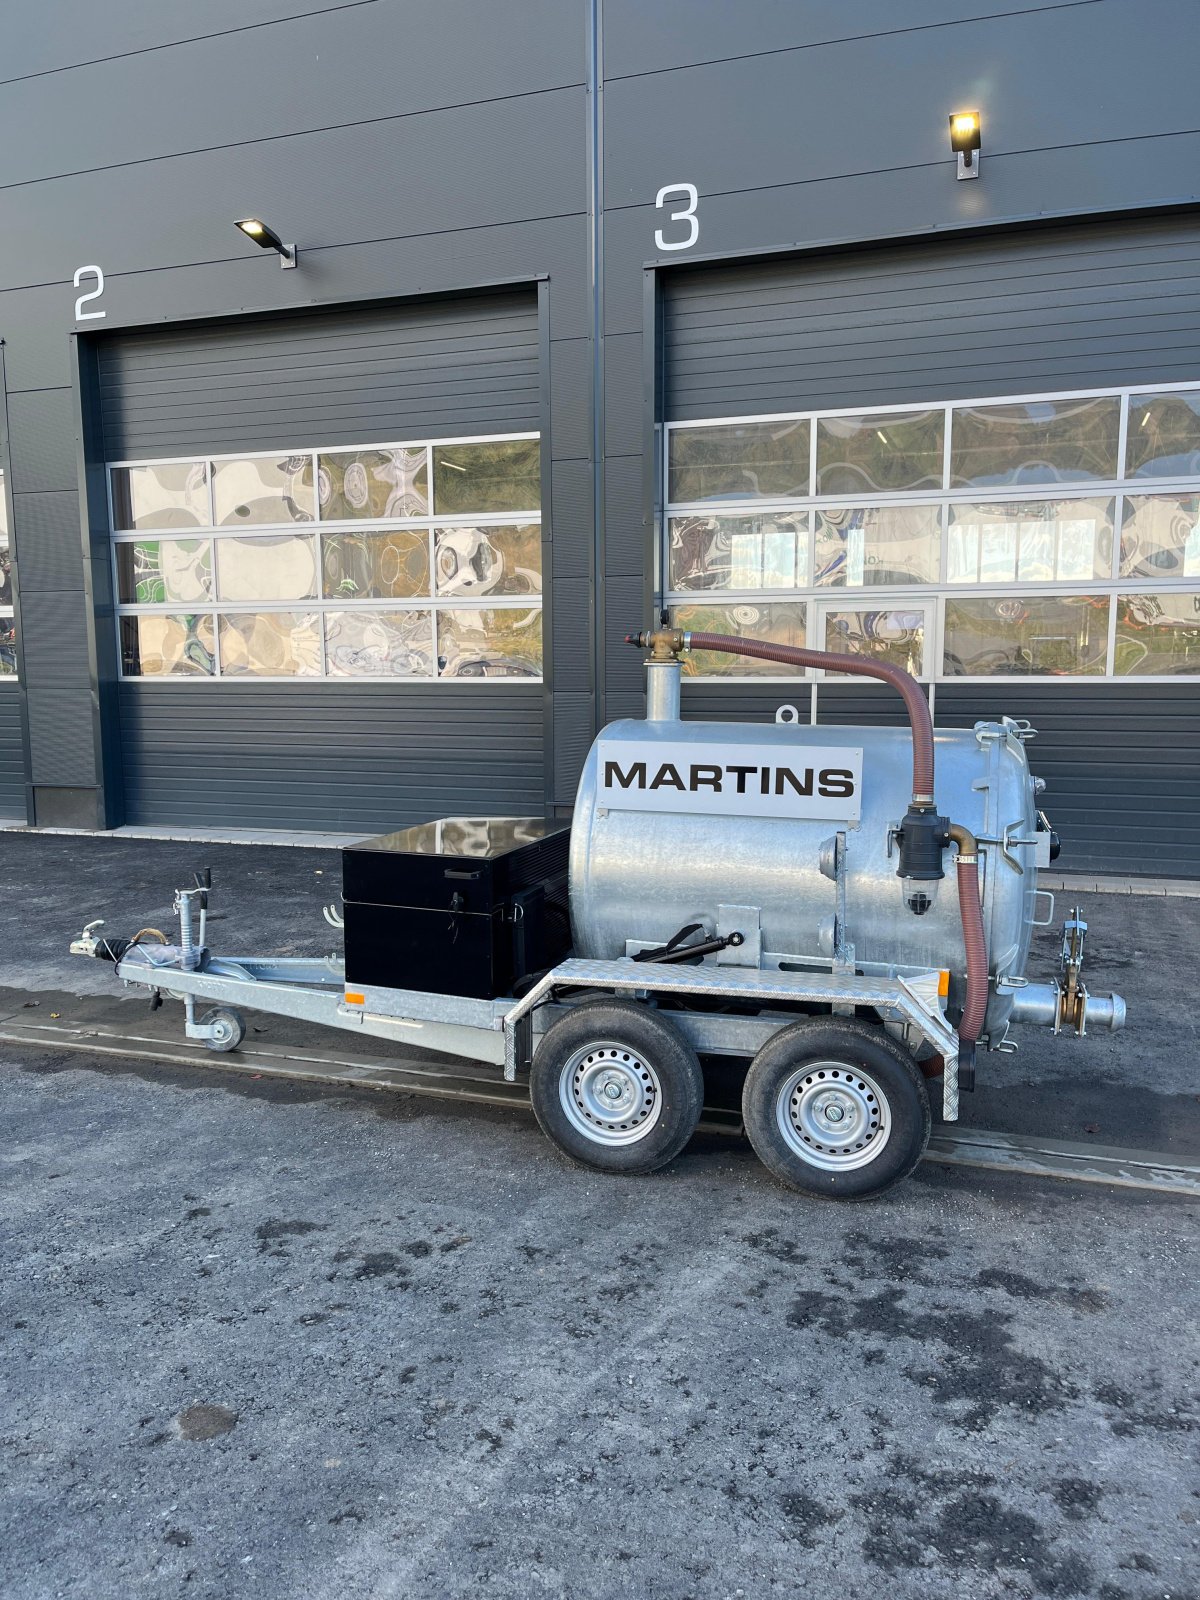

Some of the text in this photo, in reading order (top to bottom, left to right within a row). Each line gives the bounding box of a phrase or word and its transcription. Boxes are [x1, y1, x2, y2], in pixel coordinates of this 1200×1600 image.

[654, 183, 699, 251] 3
[73, 265, 106, 321] 2
[604, 761, 855, 798] MARTINS
